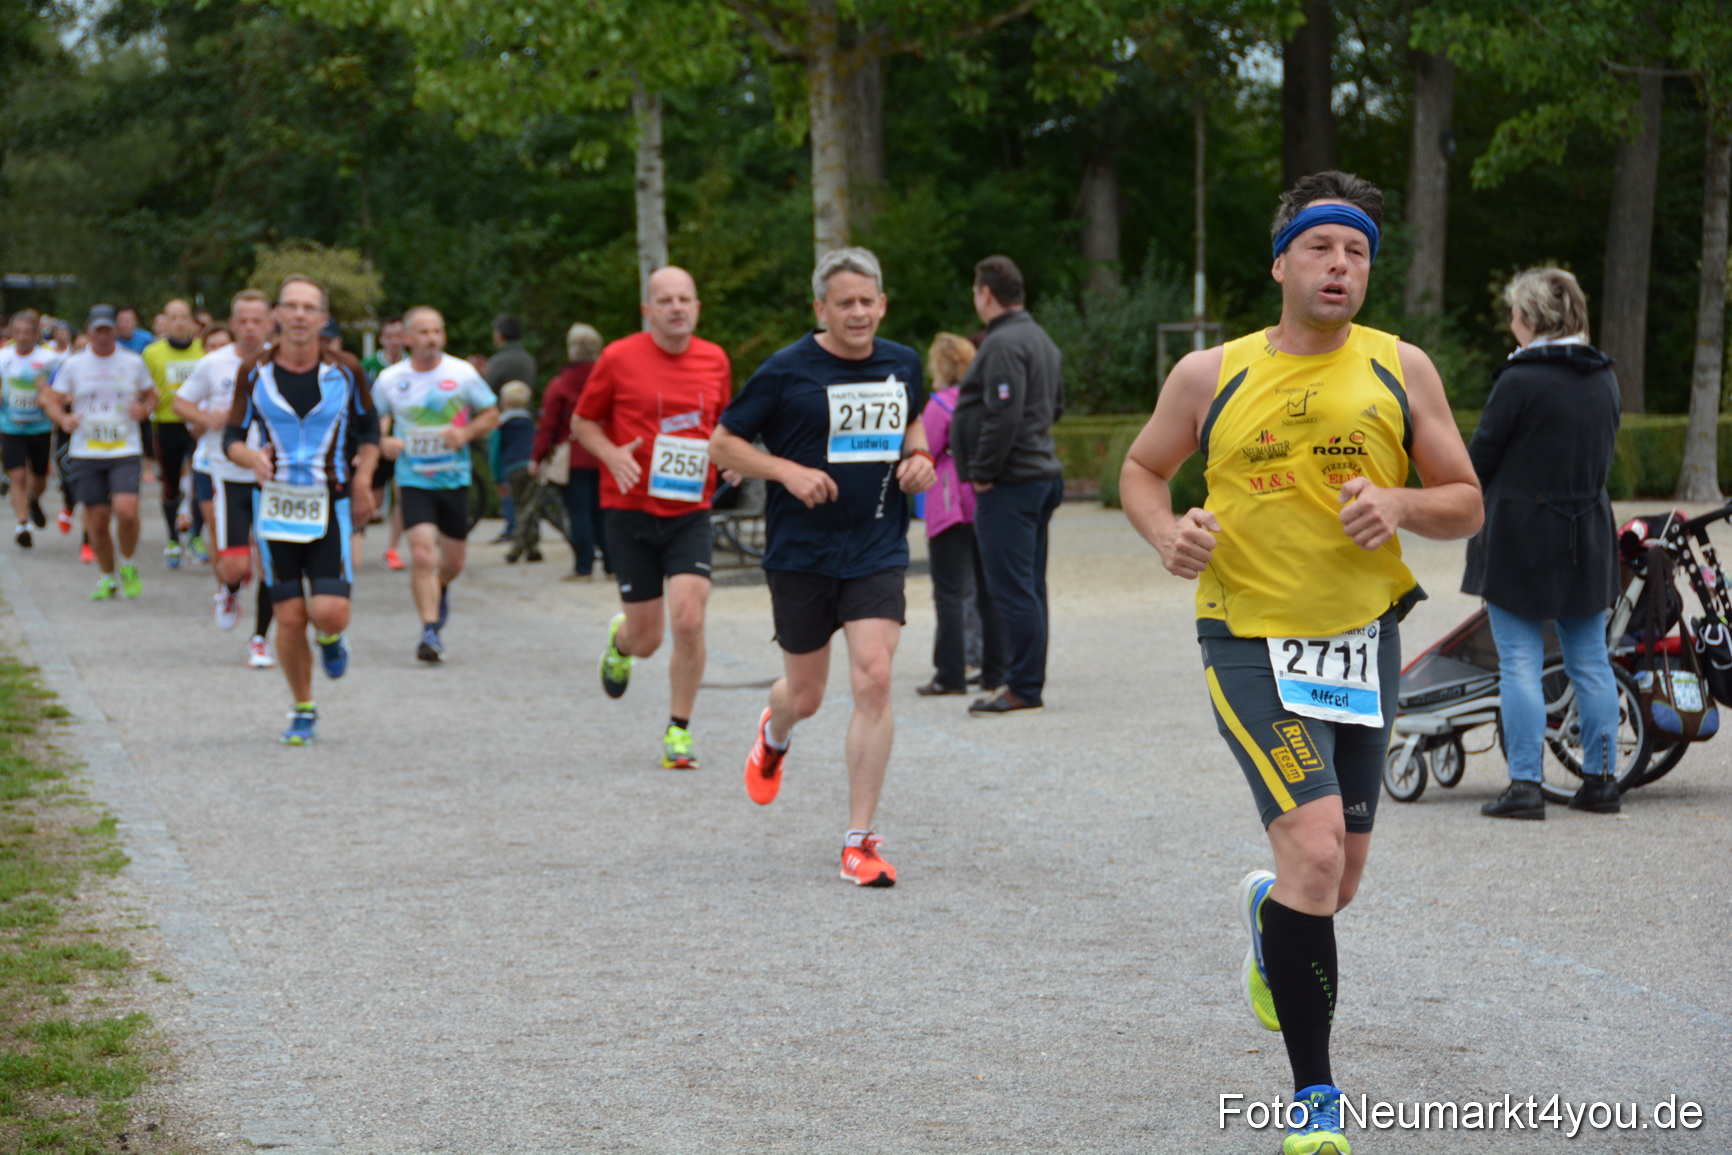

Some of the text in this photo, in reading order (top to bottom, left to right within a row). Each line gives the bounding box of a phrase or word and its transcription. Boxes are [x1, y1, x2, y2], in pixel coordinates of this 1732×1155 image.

[839, 402, 901, 431] 2173
[851, 437, 889, 450] Ludwig
[1242, 440, 1291, 459] NEUMARKTER
[1321, 461, 1362, 475] PIZZERIA
[1249, 476, 1264, 492] M
[1269, 473, 1283, 488] &
[1286, 471, 1296, 485] S
[268, 495, 321, 520] 3058
[1283, 639, 1367, 682] 2711
[1312, 689, 1349, 708] Alfred
[1282, 724, 1318, 766] Run!
[1277, 747, 1301, 779] Team
